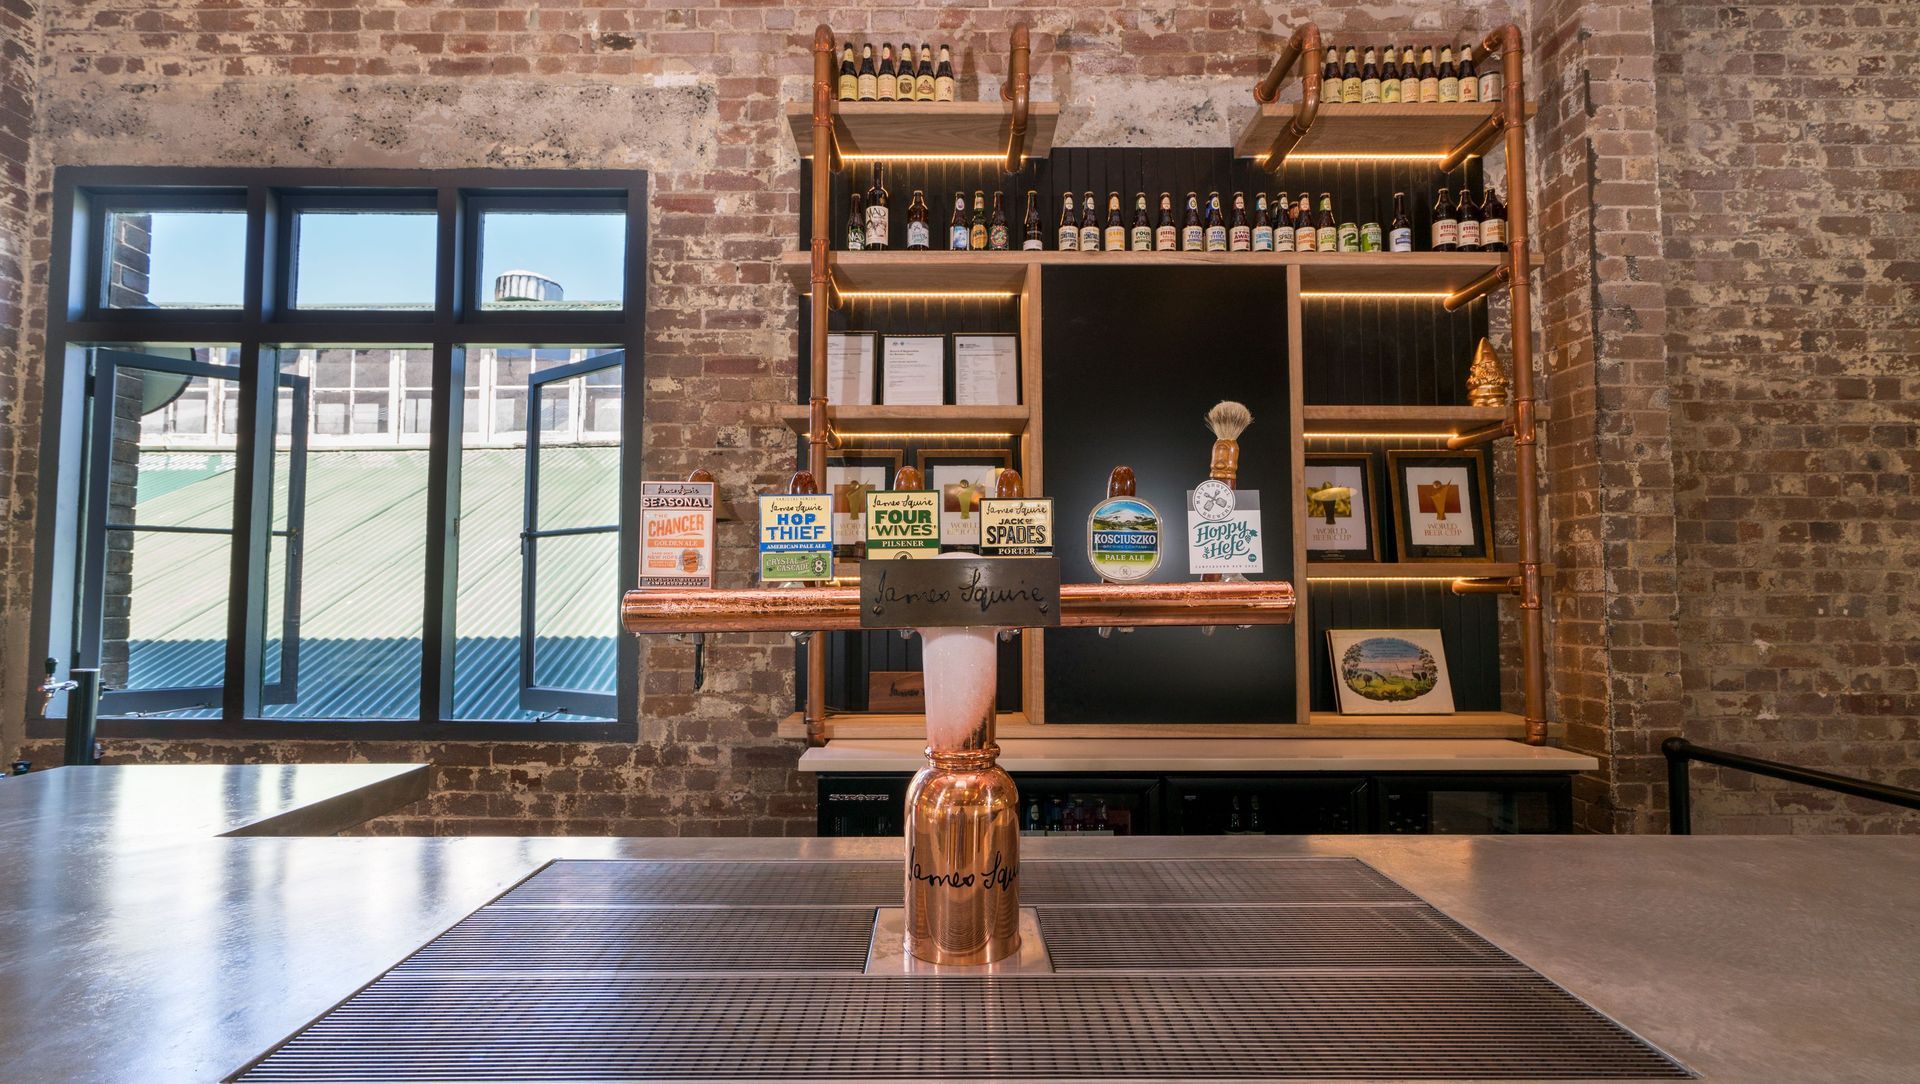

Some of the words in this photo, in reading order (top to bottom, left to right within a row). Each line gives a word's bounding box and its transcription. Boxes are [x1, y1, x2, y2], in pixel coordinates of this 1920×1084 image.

[643, 497, 711, 507] SEASONAL
[770, 501, 794, 512] James
[794, 500, 823, 513] Squire
[872, 494, 900, 508] James
[901, 494, 934, 509] Squire
[986, 502, 1014, 515] James
[1014, 502, 1047, 516] Squire
[777, 513, 816, 526] HOP
[875, 509, 932, 524] FOUR
[648, 513, 705, 537] CHANCER
[1316, 527, 1348, 535] WORLD
[1427, 522, 1458, 530] WORLD
[766, 526, 826, 540] THIEF
[986, 525, 1046, 544] SPADES
[1195, 520, 1247, 544] Hoppy
[1445, 529, 1462, 537] CUP
[1094, 534, 1156, 544] KOSCIUSZKO
[998, 547, 1036, 555] PORTER
[1210, 533, 1246, 560] Hefe
[766, 557, 799, 566] CRYSTAL
[776, 563, 809, 572] CASCADE
[815, 560, 823, 572] 8
[875, 569, 950, 605] James
[958, 568, 1044, 612] Squire
[908, 846, 975, 888] James
